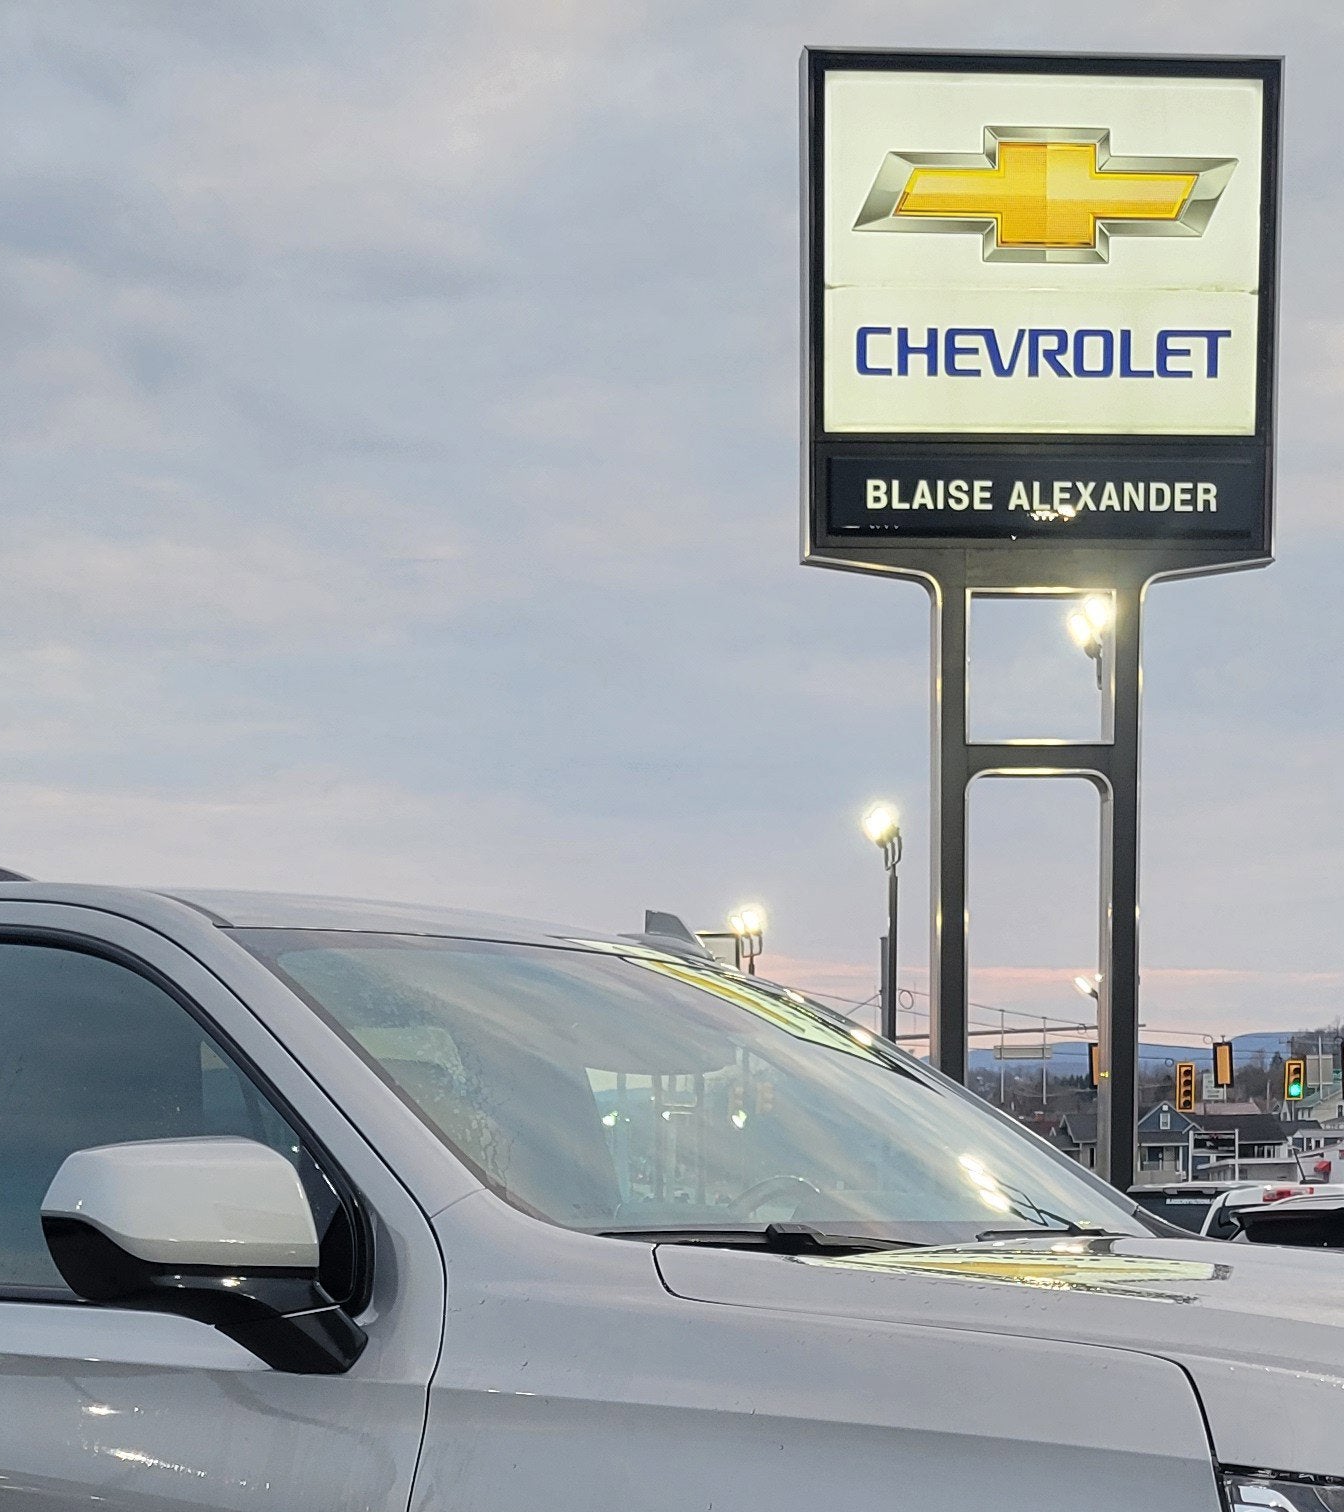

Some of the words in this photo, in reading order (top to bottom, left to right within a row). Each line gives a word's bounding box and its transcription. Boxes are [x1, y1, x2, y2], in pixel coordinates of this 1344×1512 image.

[855, 326, 1232, 379] CHEVROLET
[865, 479, 993, 511] BLAISE
[1007, 480, 1219, 513] ALEXANDER
